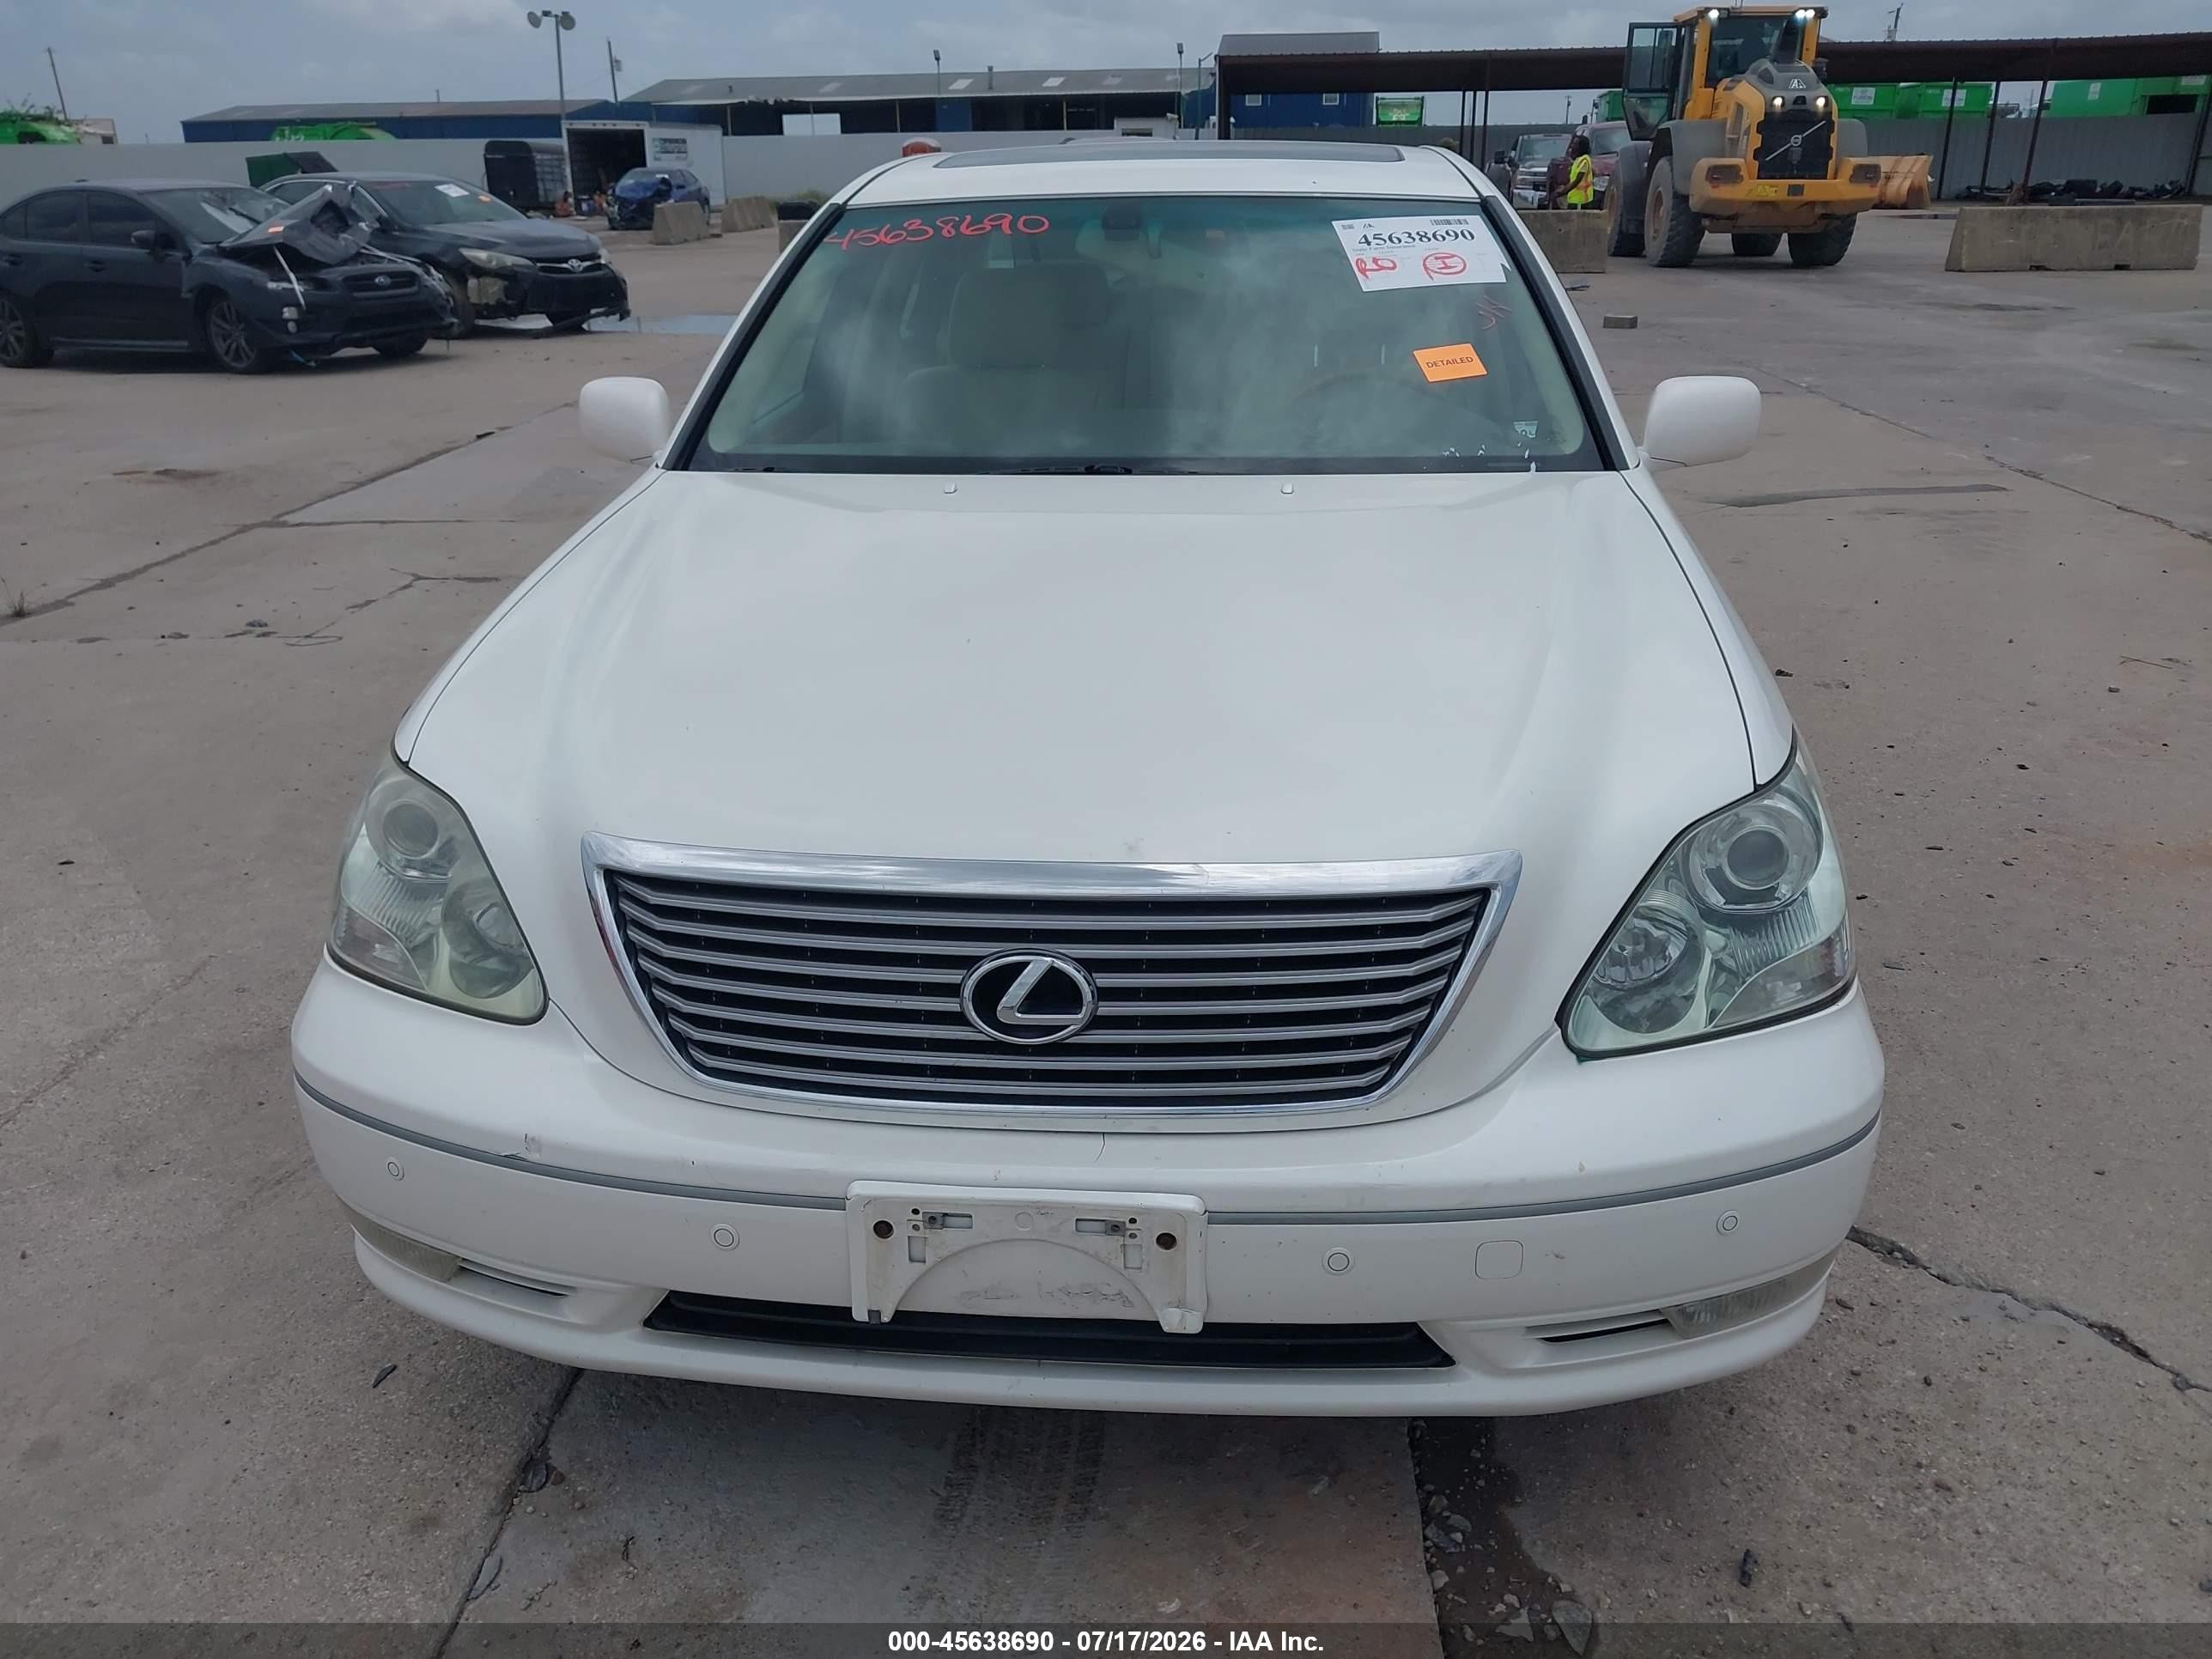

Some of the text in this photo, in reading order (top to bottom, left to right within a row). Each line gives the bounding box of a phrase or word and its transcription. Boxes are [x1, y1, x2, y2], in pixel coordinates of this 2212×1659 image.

[823, 213, 1049, 250] 45638690
[1358, 228, 1475, 246] 45638690
[1425, 356, 1474, 368] DETAILED
